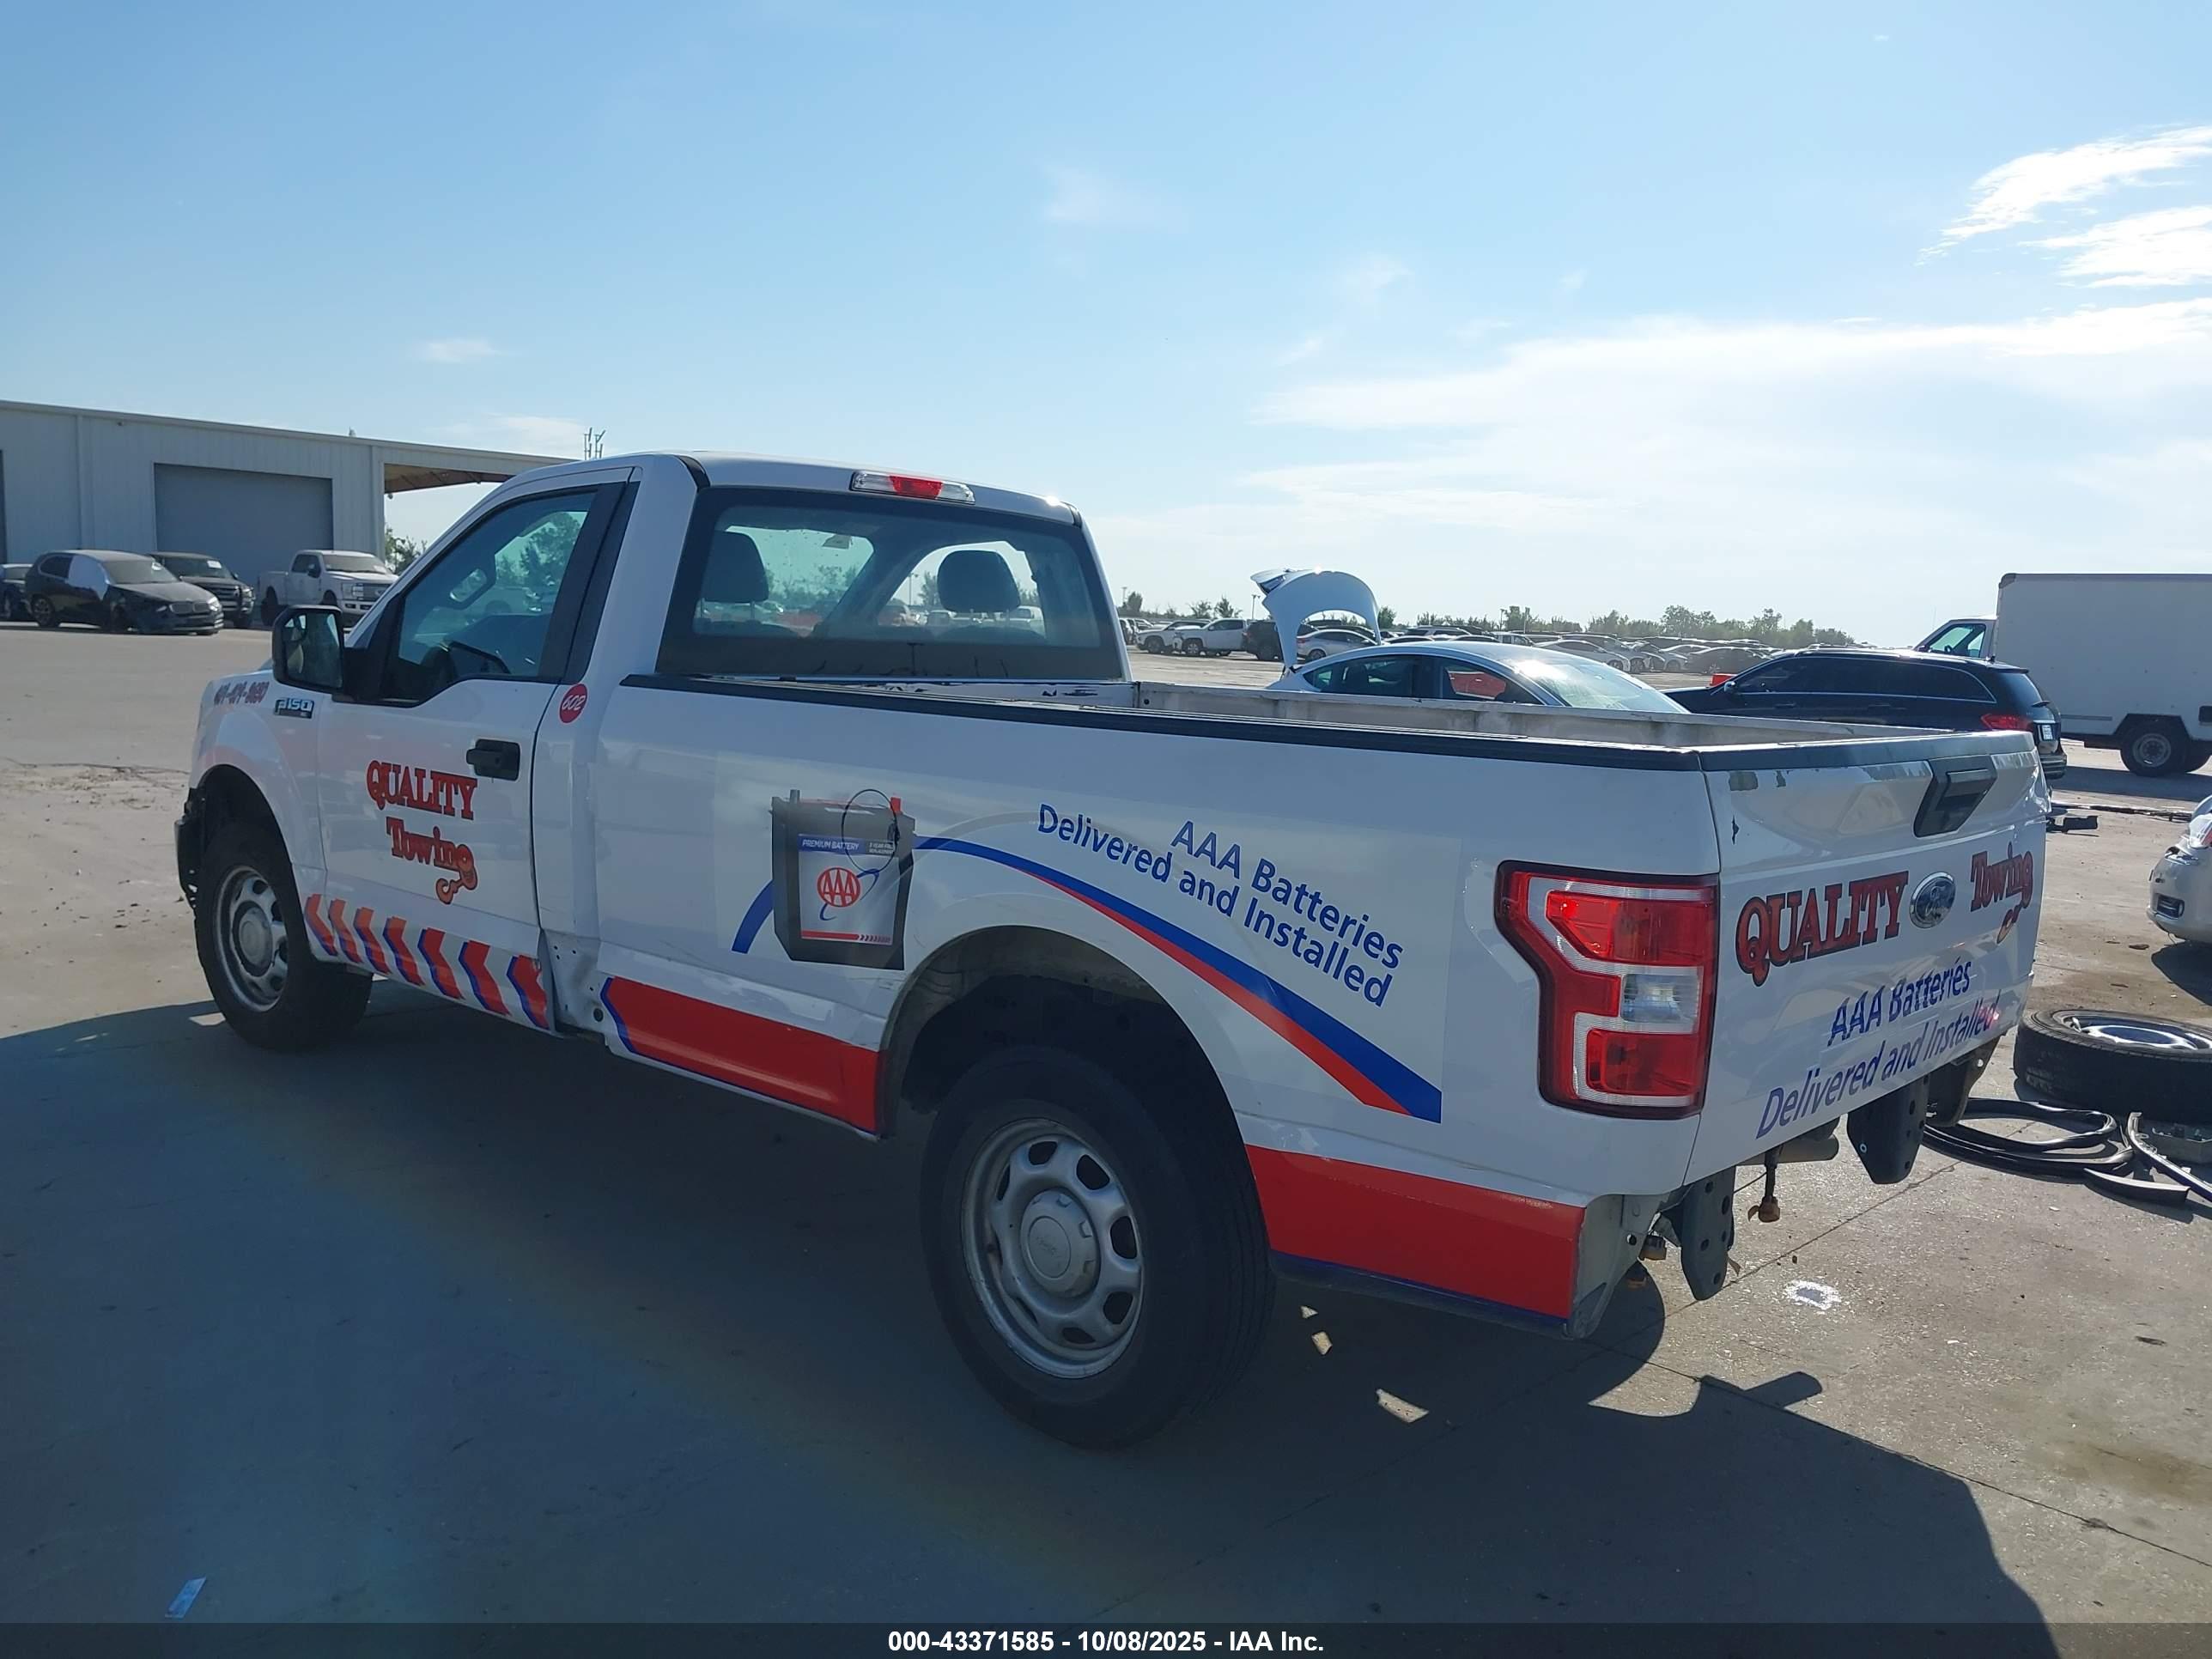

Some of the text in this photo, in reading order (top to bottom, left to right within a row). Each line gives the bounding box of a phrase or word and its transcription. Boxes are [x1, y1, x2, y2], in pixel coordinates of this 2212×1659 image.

[367, 760, 477, 820] QUALITY
[386, 817, 478, 904] Towing
[802, 839, 831, 848] PREMIUM
[831, 842, 859, 850] BATTERY
[817, 867, 860, 908] AAA
[1970, 841, 2033, 944] Towing
[1038, 804, 1393, 1007] Delivered and Installed
[1170, 820, 1404, 969] AAA Batteries
[1735, 870, 1910, 988] QUALITY
[1826, 957, 1972, 1048] AAA Batteries
[1754, 998, 2001, 1140] Delivered and Installed
